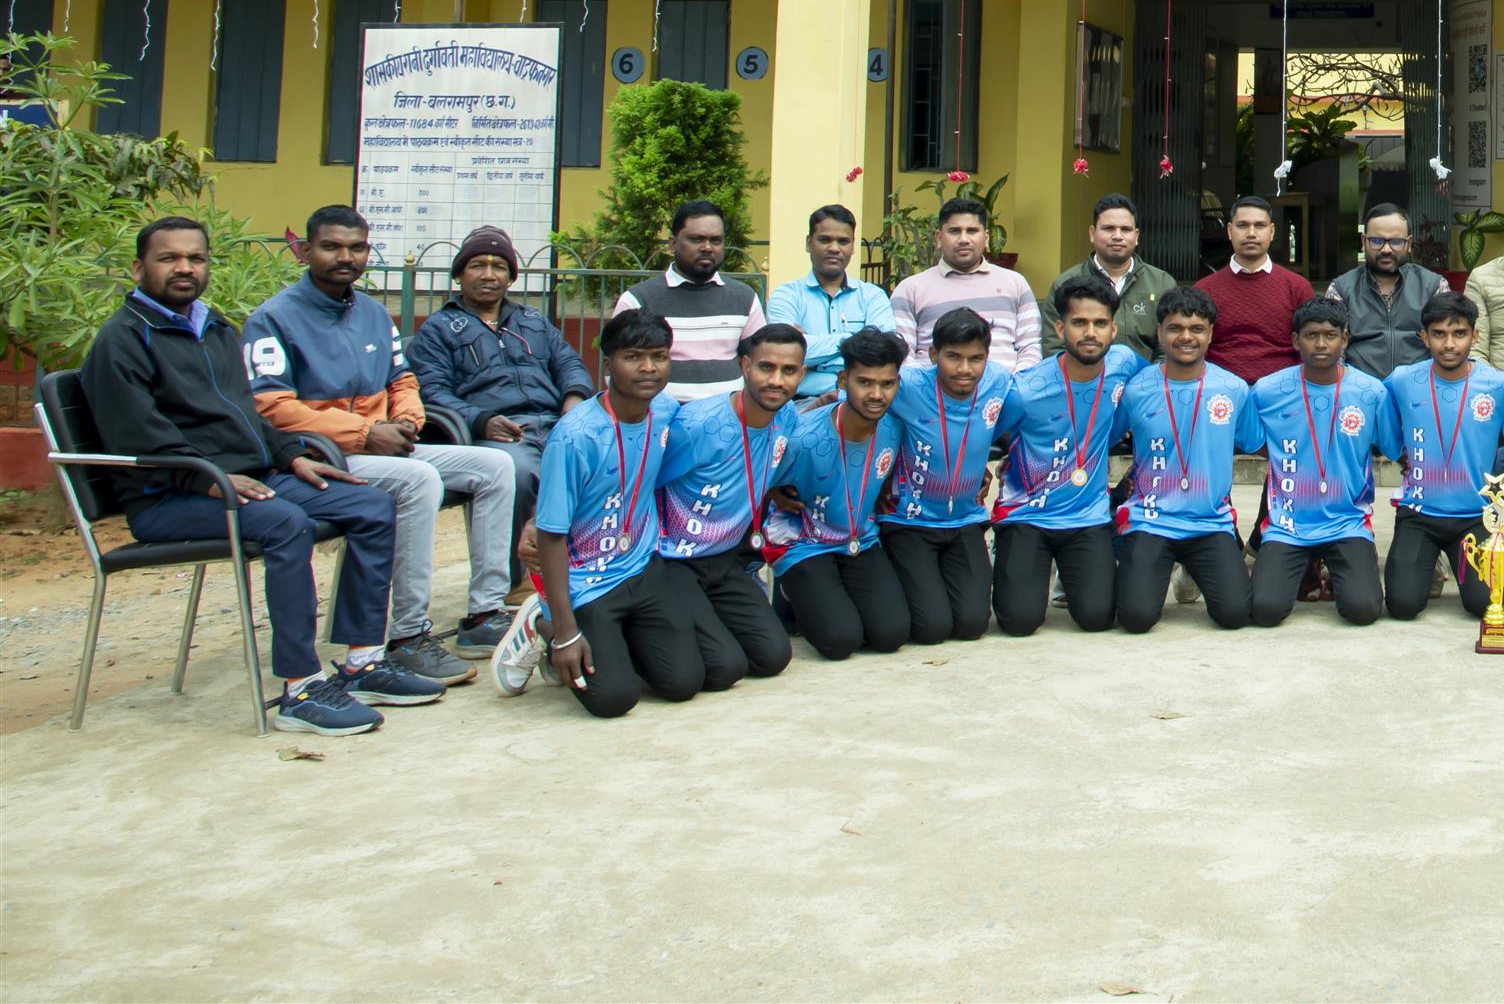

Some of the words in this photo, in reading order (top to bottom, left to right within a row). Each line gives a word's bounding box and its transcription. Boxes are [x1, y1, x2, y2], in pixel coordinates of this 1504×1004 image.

[423, 40, 460, 76] दुर्गावती
[618, 53, 634, 74] 6
[743, 54, 759, 73] 5
[869, 54, 884, 76] 4
